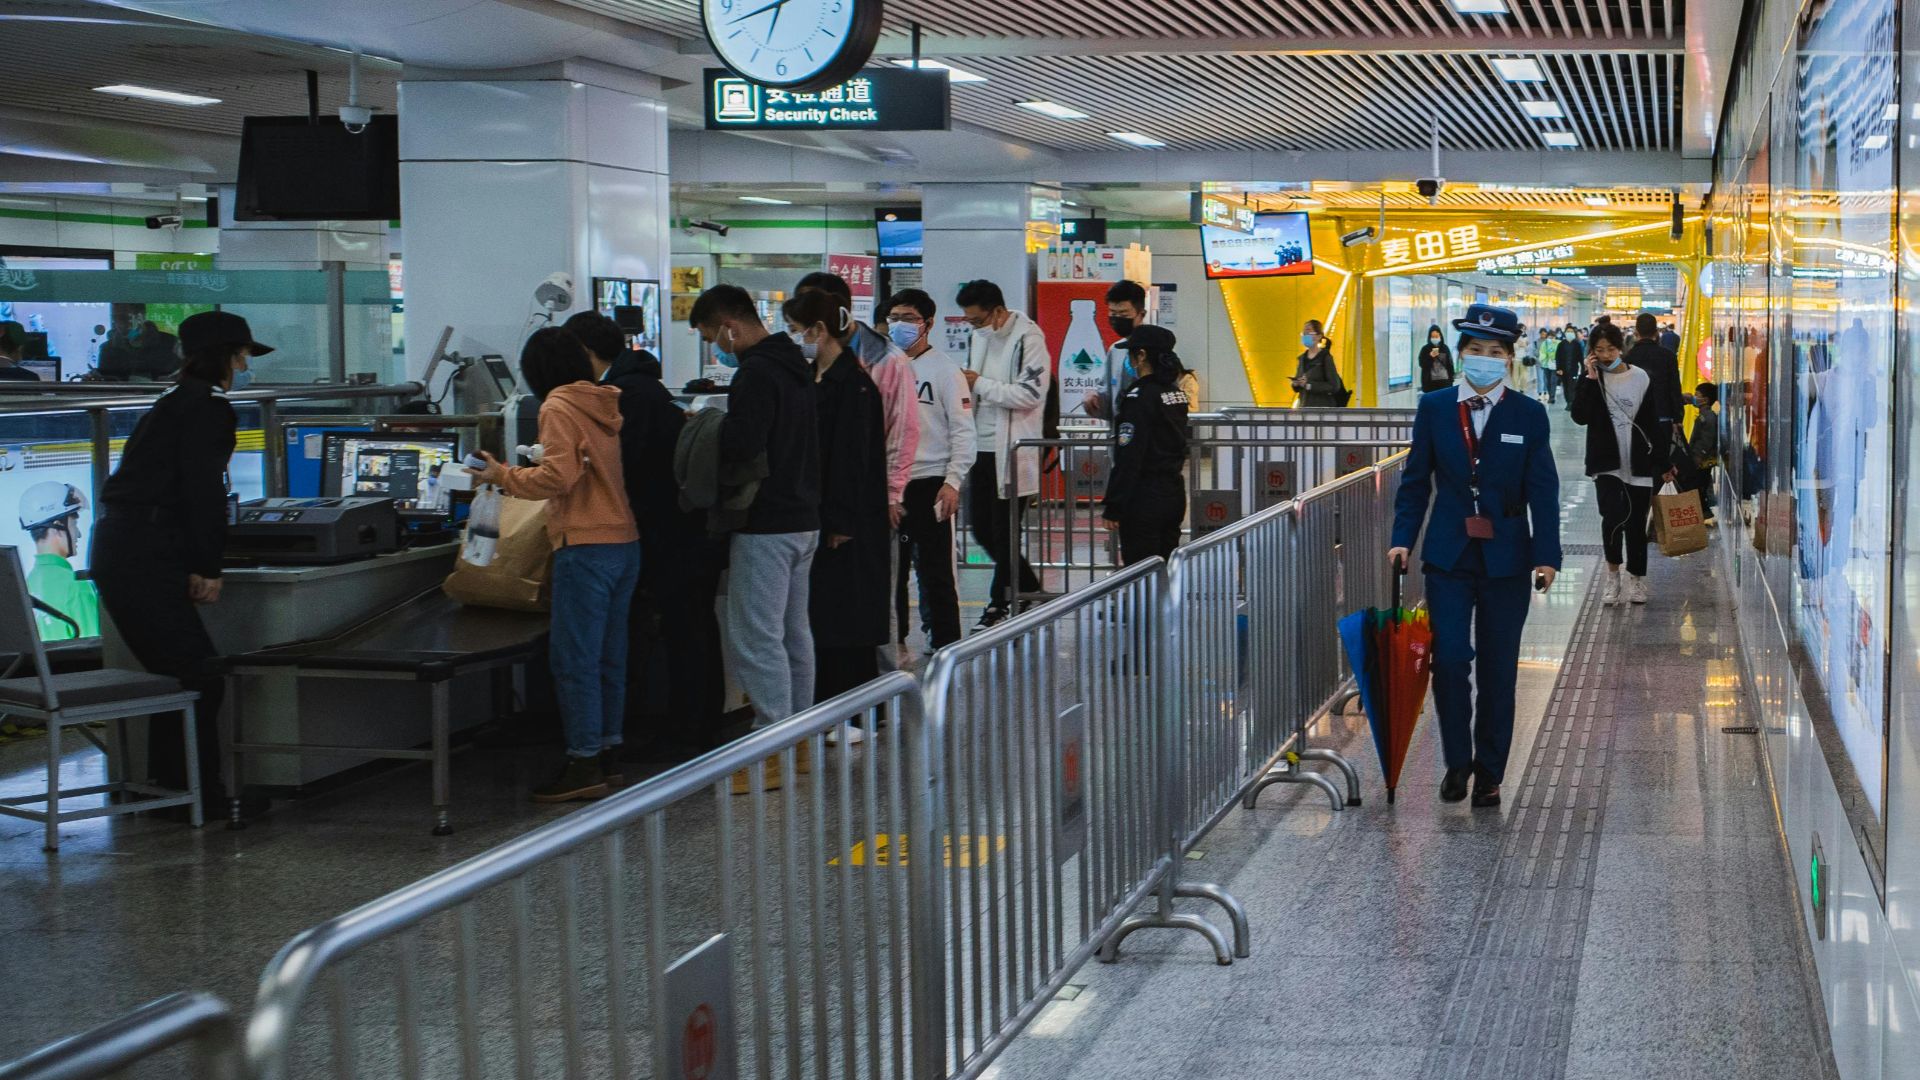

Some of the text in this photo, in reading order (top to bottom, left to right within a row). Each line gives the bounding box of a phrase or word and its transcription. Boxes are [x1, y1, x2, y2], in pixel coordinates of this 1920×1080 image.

[776, 58, 787, 76] 6
[765, 108, 878, 124] Security Check
[1060, 222, 1077, 234] 票
[1380, 224, 1481, 267] 麦田里
[1475, 245, 1575, 272] 地铁商业街
[830, 262, 873, 285] 安全检查
